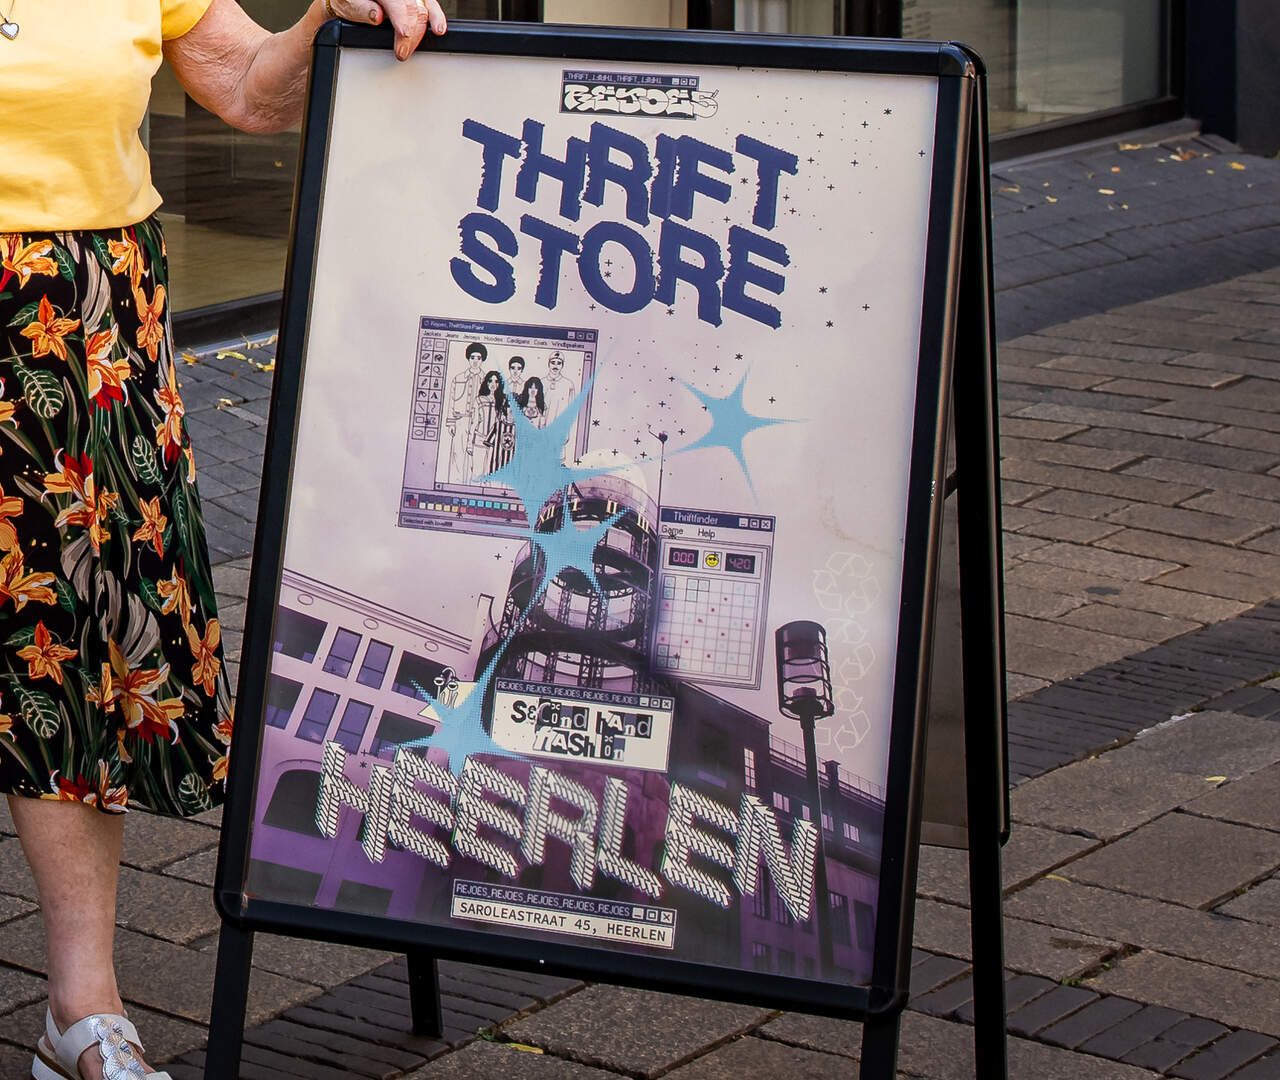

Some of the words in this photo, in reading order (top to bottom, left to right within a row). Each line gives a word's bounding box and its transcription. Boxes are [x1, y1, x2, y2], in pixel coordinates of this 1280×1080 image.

[461, 117, 799, 231] THRIFT
[449, 212, 791, 330] STORE
[662, 524, 684, 536] Game
[698, 528, 716, 540] Help
[673, 511, 719, 526] Thriftfinder
[672, 551, 695, 565] 000
[317, 739, 818, 922] HEERLEN
[459, 901, 566, 928] SAROLEASTRAAT
[574, 918, 598, 935] 45,
[607, 922, 666, 942] HEERLEN
